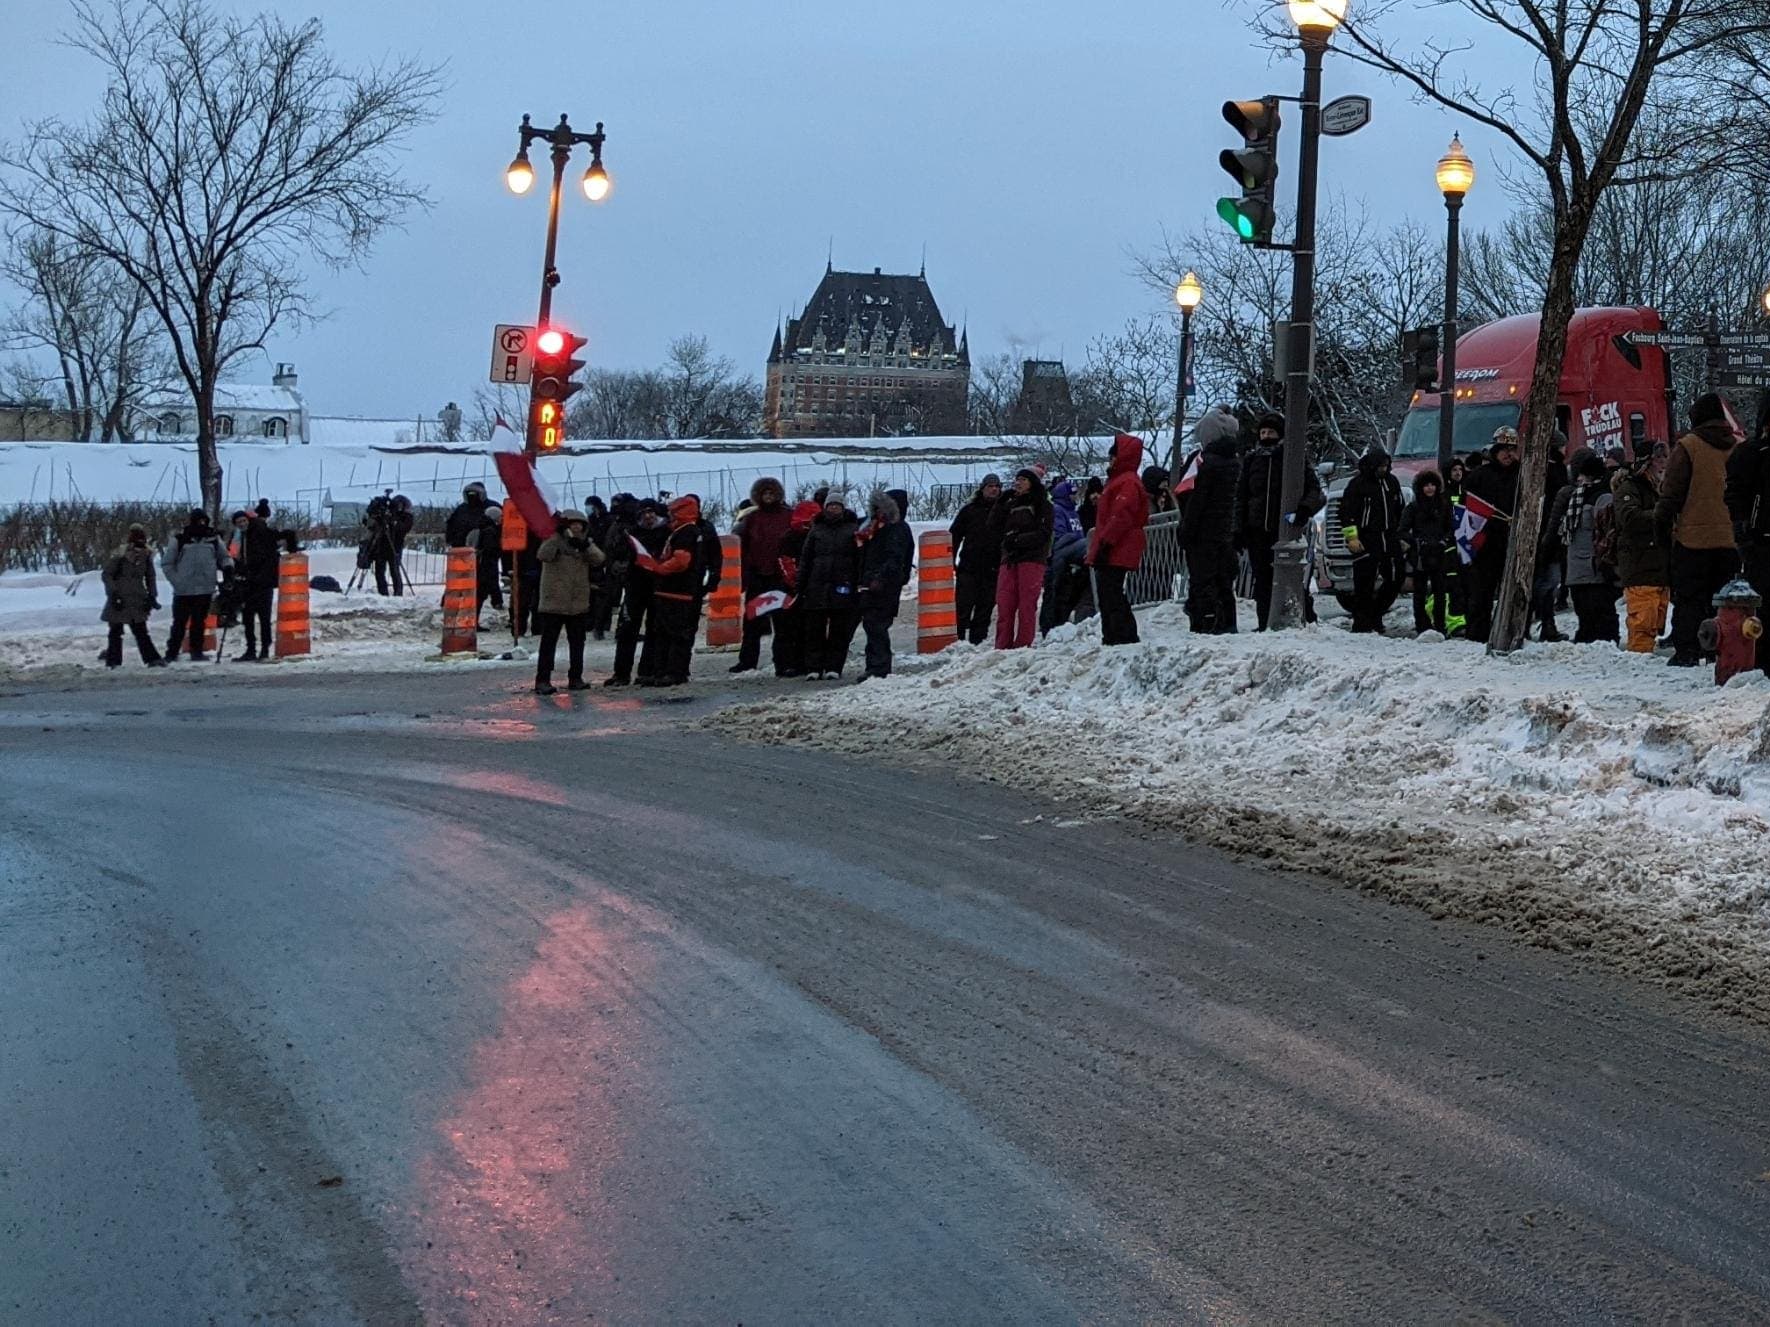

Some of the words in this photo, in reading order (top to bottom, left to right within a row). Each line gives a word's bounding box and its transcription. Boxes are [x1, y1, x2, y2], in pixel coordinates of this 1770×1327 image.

[1728, 355, 1742, 365] Grand
[1737, 374, 1752, 385] Hôtel
[1754, 375, 1763, 385] du
[1585, 417, 1622, 437] TRUDEAU
